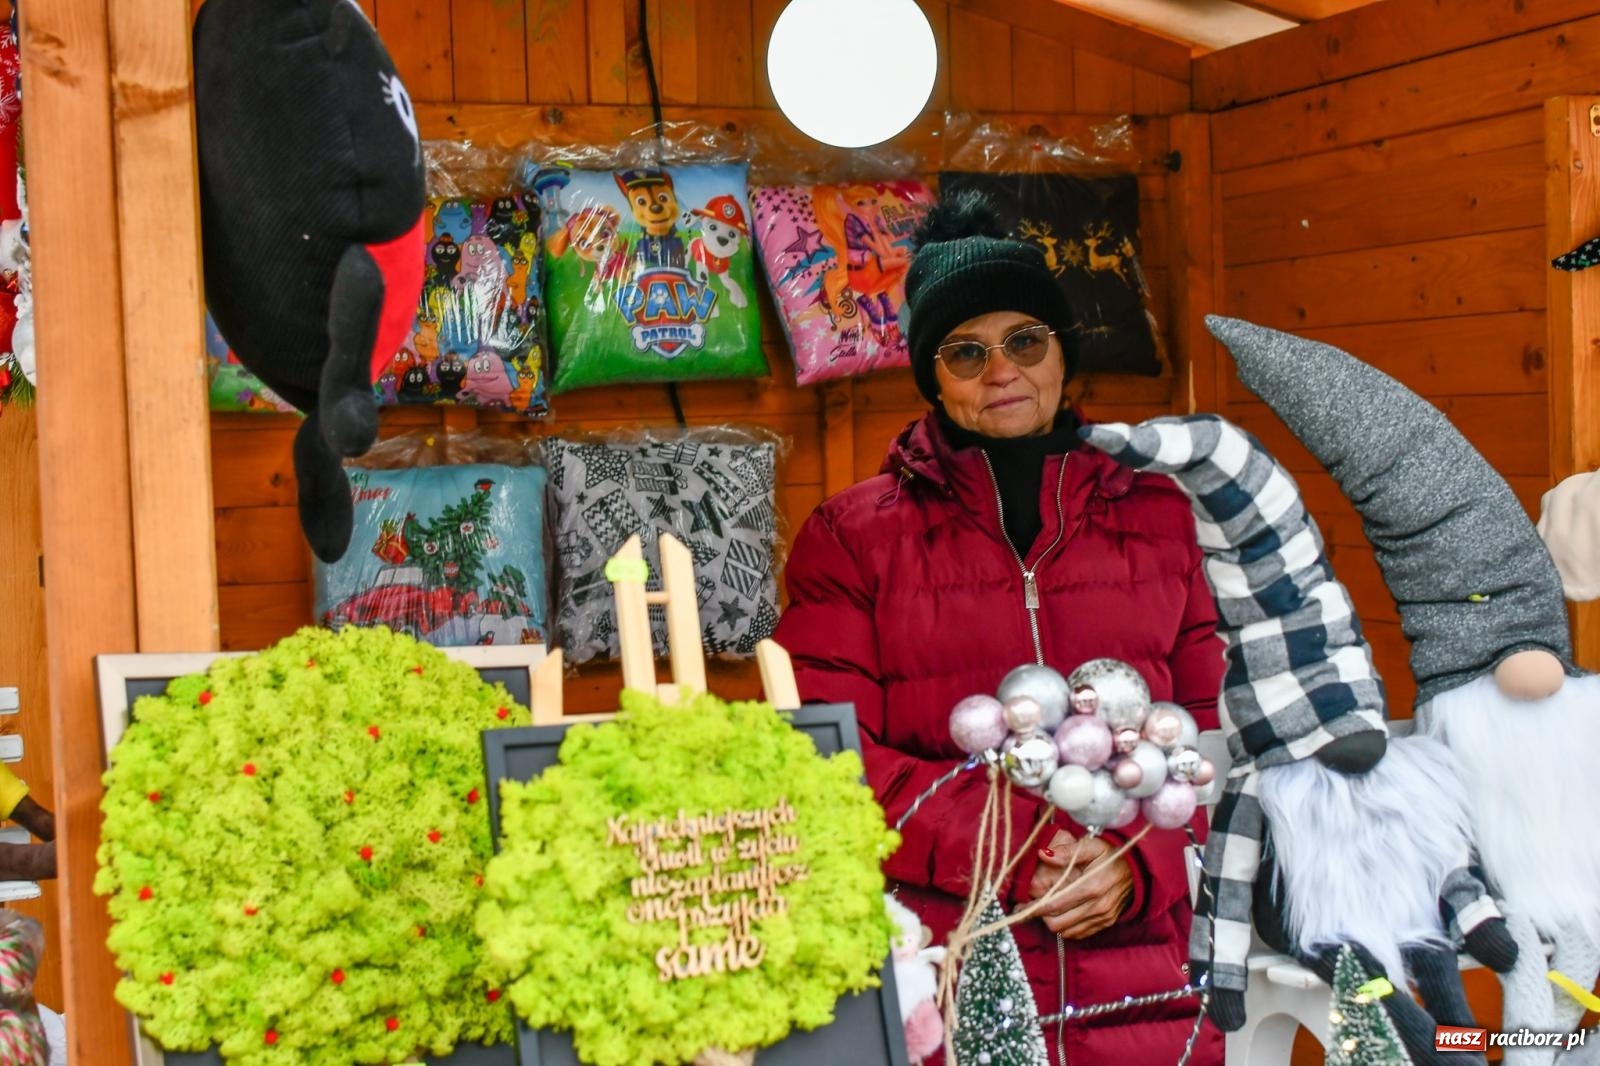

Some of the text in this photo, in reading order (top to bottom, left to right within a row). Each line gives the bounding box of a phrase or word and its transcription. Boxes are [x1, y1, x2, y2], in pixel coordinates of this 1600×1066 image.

[613, 281, 718, 326] PAW
[641, 327, 697, 341] PATROL
[655, 934, 766, 983] same
